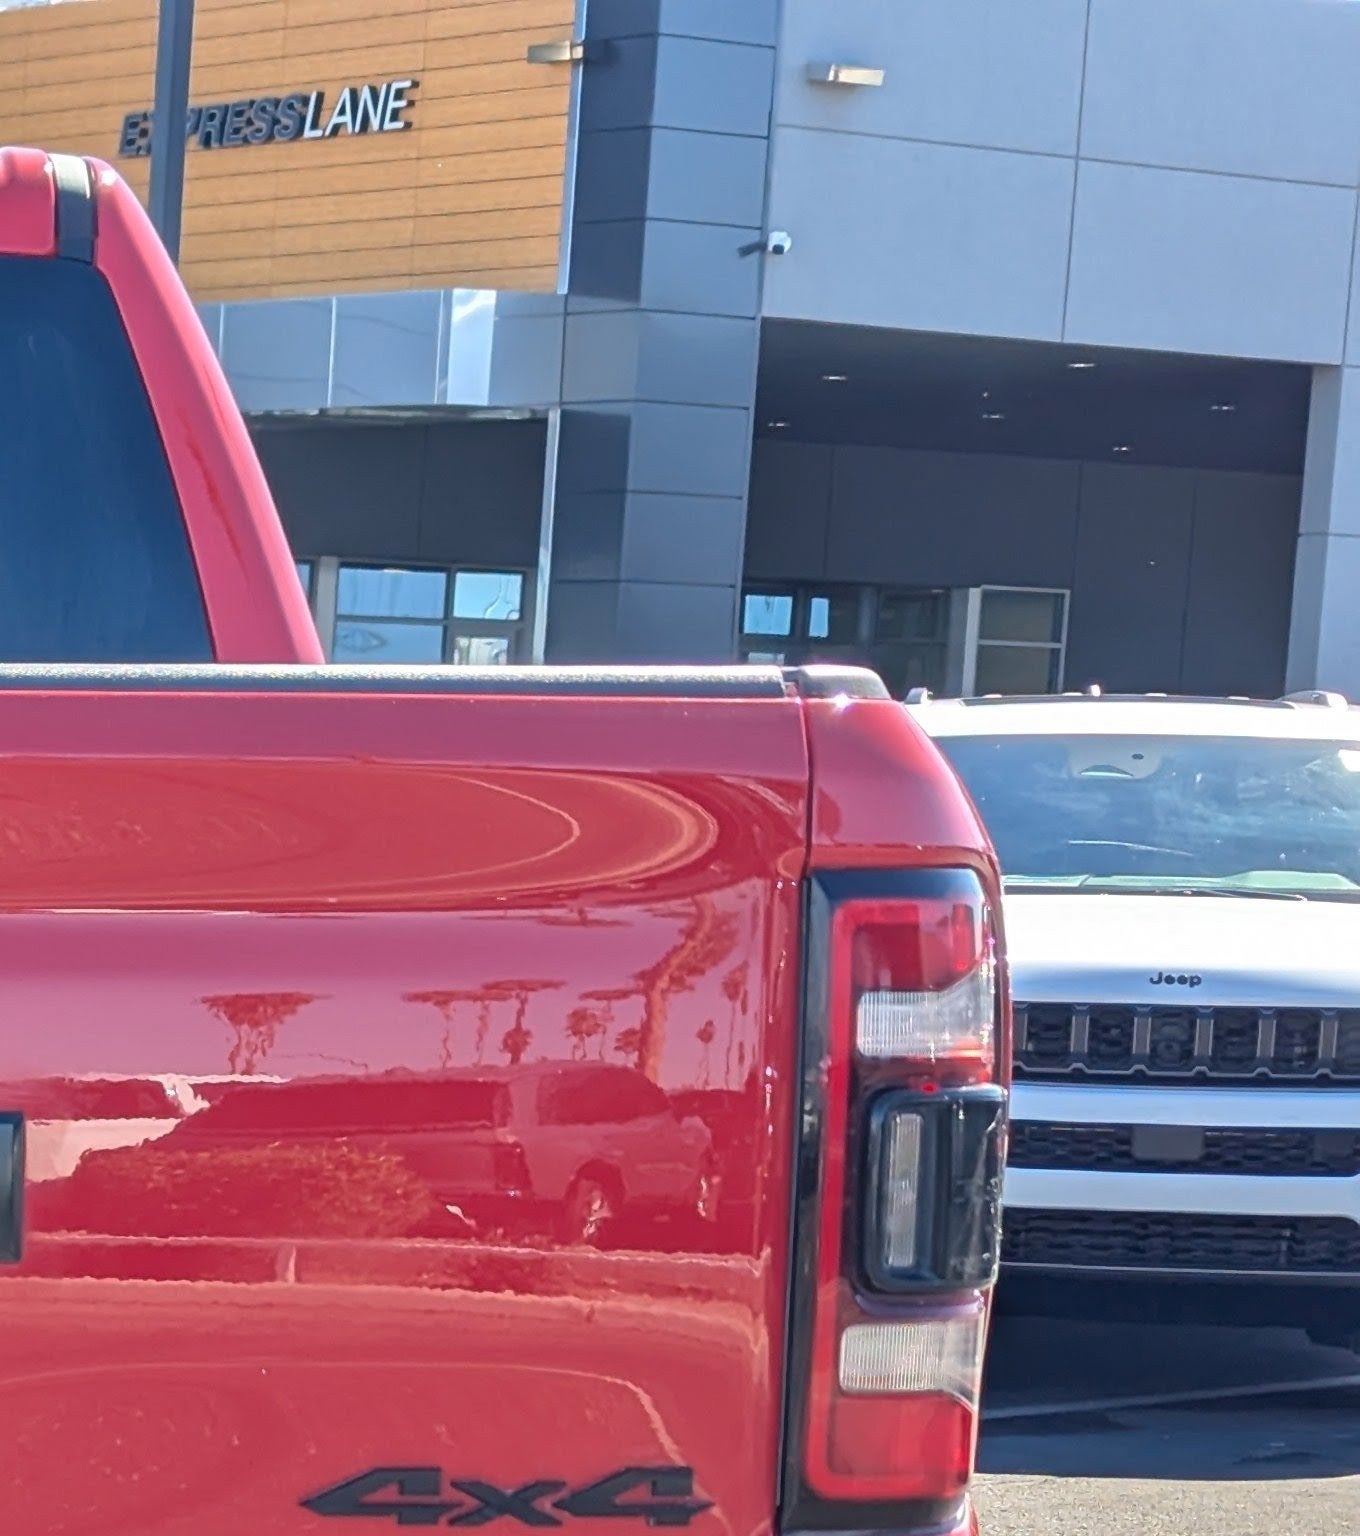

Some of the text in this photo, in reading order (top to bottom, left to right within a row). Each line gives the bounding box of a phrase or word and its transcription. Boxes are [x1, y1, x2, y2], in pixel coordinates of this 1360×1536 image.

[118, 79, 418, 155] EPRESSLANE
[1148, 971, 1202, 988] Jeep
[298, 1466, 717, 1527] 4x4
